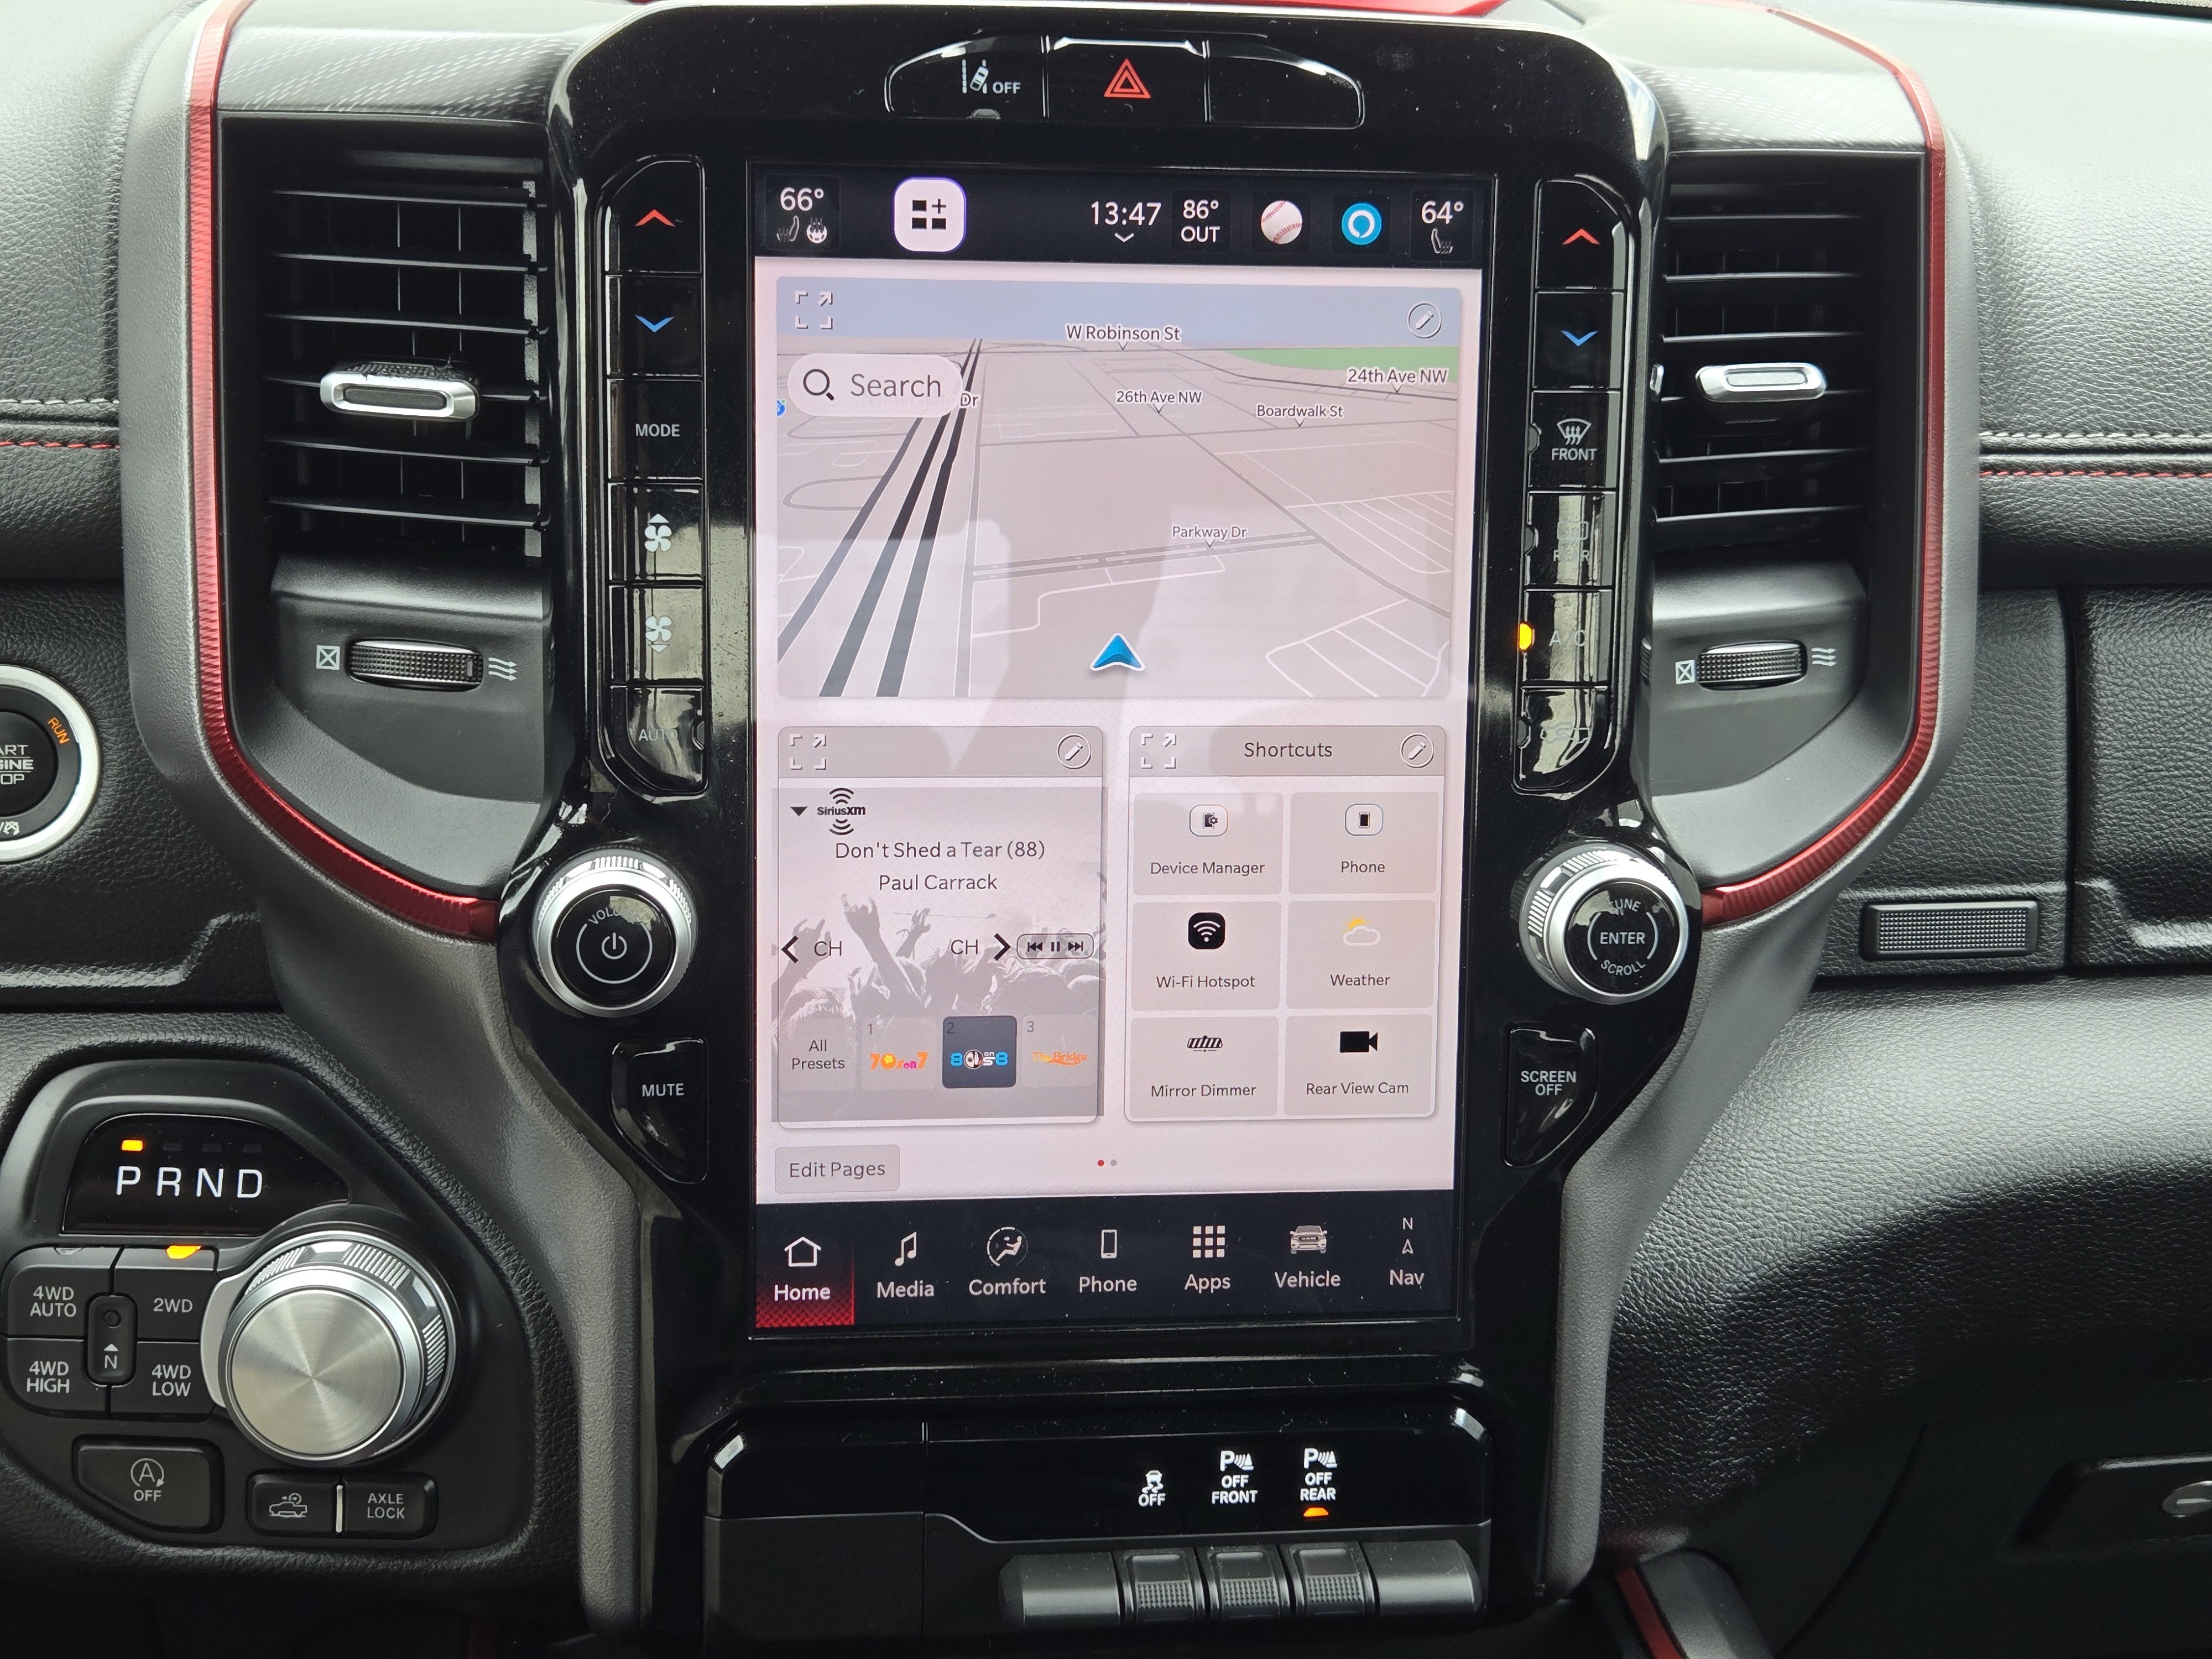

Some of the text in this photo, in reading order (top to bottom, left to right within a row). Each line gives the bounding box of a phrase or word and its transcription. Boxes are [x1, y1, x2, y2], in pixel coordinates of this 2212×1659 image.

[993, 82, 1021, 95] OFF
[780, 187, 824, 211] 66°
[1092, 201, 1161, 225] 13:47
[1183, 199, 1219, 219] 86°
[1421, 201, 1464, 225] 64°
[1181, 226, 1220, 243] OUT
[1066, 325, 1180, 341] W Robinson St
[1347, 369, 1448, 384] 24th Ave NW
[851, 373, 941, 398] Search
[960, 393, 979, 406] Dr
[1116, 392, 1202, 404] 26th Ave NW
[1256, 405, 1343, 418] Boardwalk St
[635, 424, 680, 437] MODE
[1551, 448, 1598, 461] FRONT
[1172, 525, 1247, 541] Parkway Dr
[1548, 629, 1587, 647] A/C
[48, 717, 70, 744] RUN
[638, 728, 678, 742] AUTO
[1244, 742, 1333, 758] Shortcuts
[836, 840, 1045, 859] Don't Shed a Tear (88)
[1151, 862, 1265, 877] Device Manager
[1340, 860, 1385, 874] Phone
[879, 874, 998, 890] Paul Carrack
[1609, 898, 1641, 912] TUNE
[1600, 932, 1646, 945] ENTER
[813, 941, 842, 957] CH
[951, 940, 979, 956] CH
[1600, 959, 1646, 976] SCROLL
[1156, 975, 1255, 991] Wi-Fi Hotspot
[1330, 974, 1391, 987] Weather
[868, 1024, 873, 1035] 1
[946, 1022, 956, 1034] 2
[1026, 1021, 1035, 1033] 3
[808, 1039, 827, 1051] All
[791, 1058, 845, 1071] Presets
[1053, 1052, 1088, 1066] Bridge
[1521, 1070, 1577, 1083] SCREEN
[641, 1083, 685, 1097] MUTE
[1151, 1083, 1257, 1097] Mirror Dimmer
[1306, 1082, 1409, 1095] Rear View Cam
[1535, 1083, 1562, 1096] OFF
[790, 1162, 886, 1180] Edit Pages
[1402, 1217, 1413, 1230] N
[1079, 1276, 1138, 1292] Phone
[1184, 1274, 1231, 1293] Apps
[1274, 1270, 1341, 1288] Vehicle
[1390, 1269, 1425, 1286] Nav
[33, 1285, 75, 1301] 4WD
[774, 1284, 831, 1301] Home
[877, 1281, 935, 1298] Media
[968, 1277, 1046, 1296] Comfort
[30, 1301, 77, 1318] AUTO
[153, 1297, 194, 1314] 2WD
[29, 1360, 69, 1377] 4WD
[105, 1354, 117, 1370] N
[152, 1364, 191, 1380] 4WD
[26, 1378, 70, 1394] HIGH
[152, 1381, 191, 1397] LOW
[1221, 1474, 1249, 1489] OFF
[1305, 1472, 1333, 1486] OFF
[133, 1489, 162, 1503] OFF
[368, 1493, 404, 1505] AXLE
[1138, 1493, 1166, 1507] OFF
[1211, 1490, 1258, 1504] FRONT
[1300, 1487, 1337, 1501] REAR
[366, 1505, 406, 1520] LOCK
